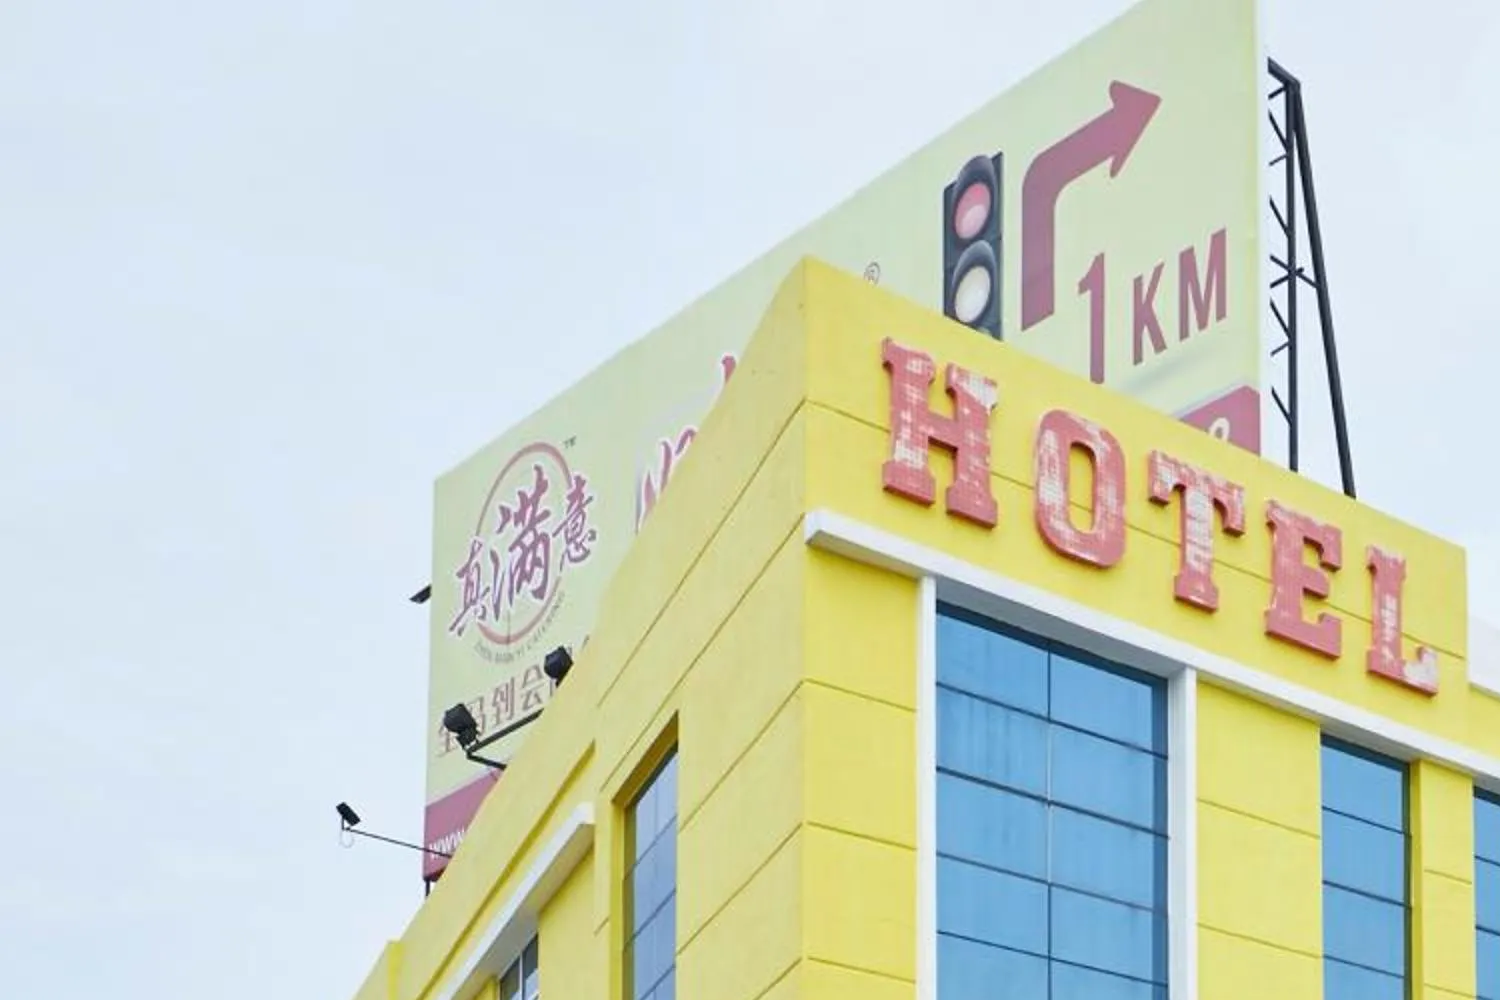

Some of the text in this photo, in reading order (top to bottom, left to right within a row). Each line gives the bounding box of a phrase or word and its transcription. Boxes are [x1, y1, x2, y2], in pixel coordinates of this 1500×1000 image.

[1078, 228, 1228, 384] 1 KM
[881, 336, 1438, 697] HOTEL
